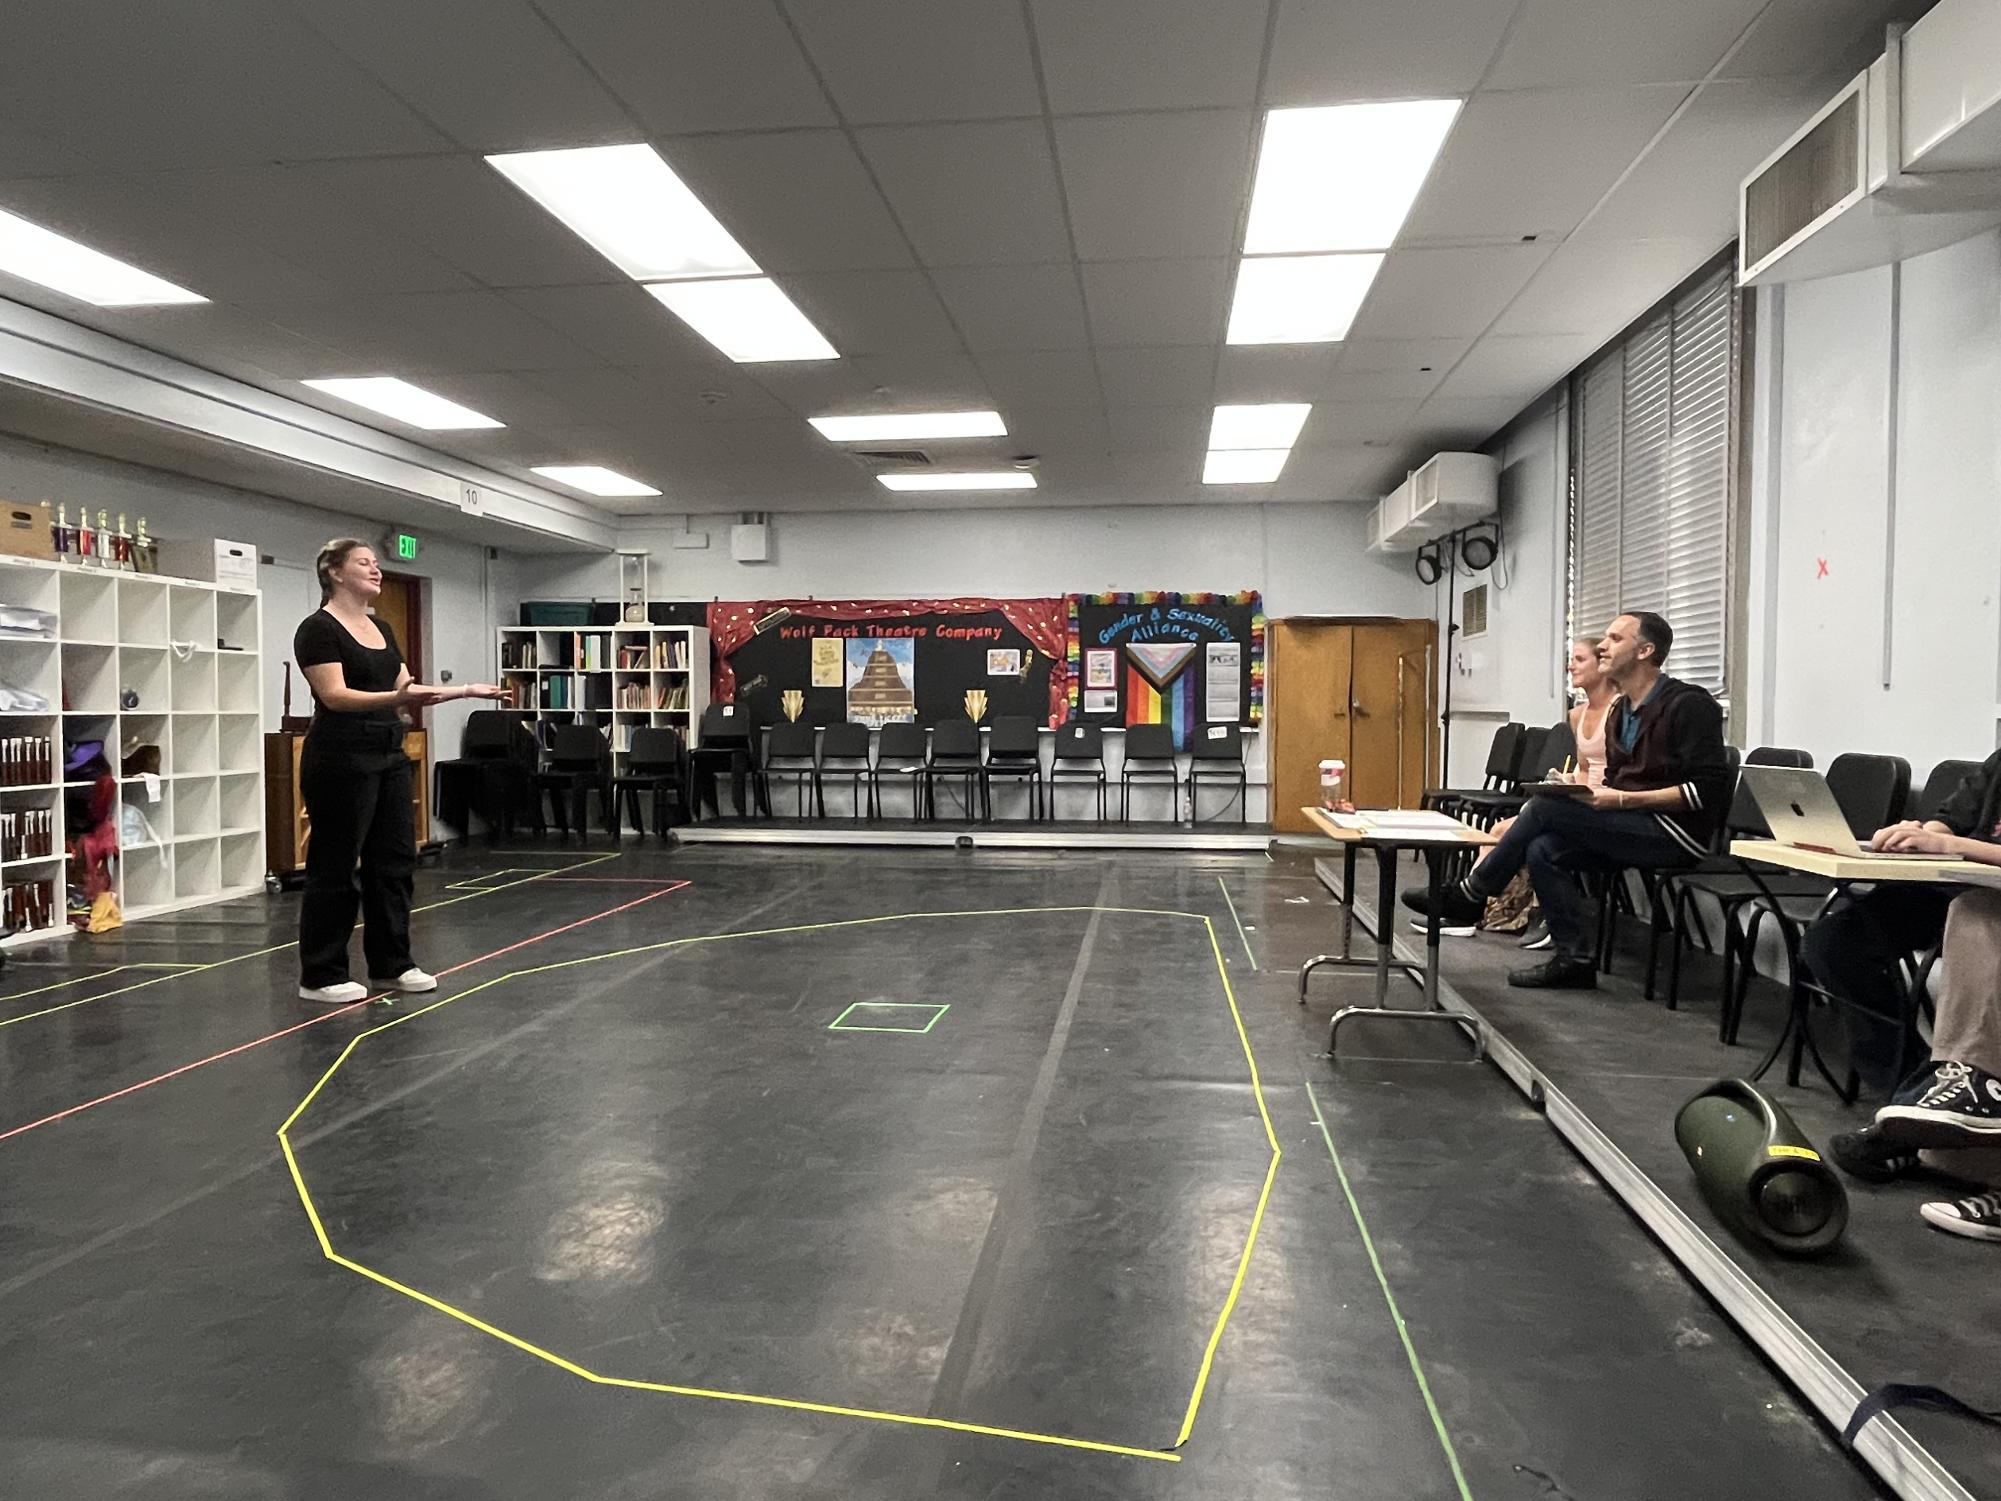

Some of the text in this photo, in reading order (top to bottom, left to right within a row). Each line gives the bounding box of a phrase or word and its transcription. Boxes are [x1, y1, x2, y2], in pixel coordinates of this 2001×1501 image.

[466, 489, 478, 505] 10
[399, 534, 417, 559] EXIT
[780, 624, 1002, 640] Wolf Pack Theatre Company
[1098, 607, 1236, 645] Gender & Sexuality
[1131, 621, 1199, 642] Alliance
